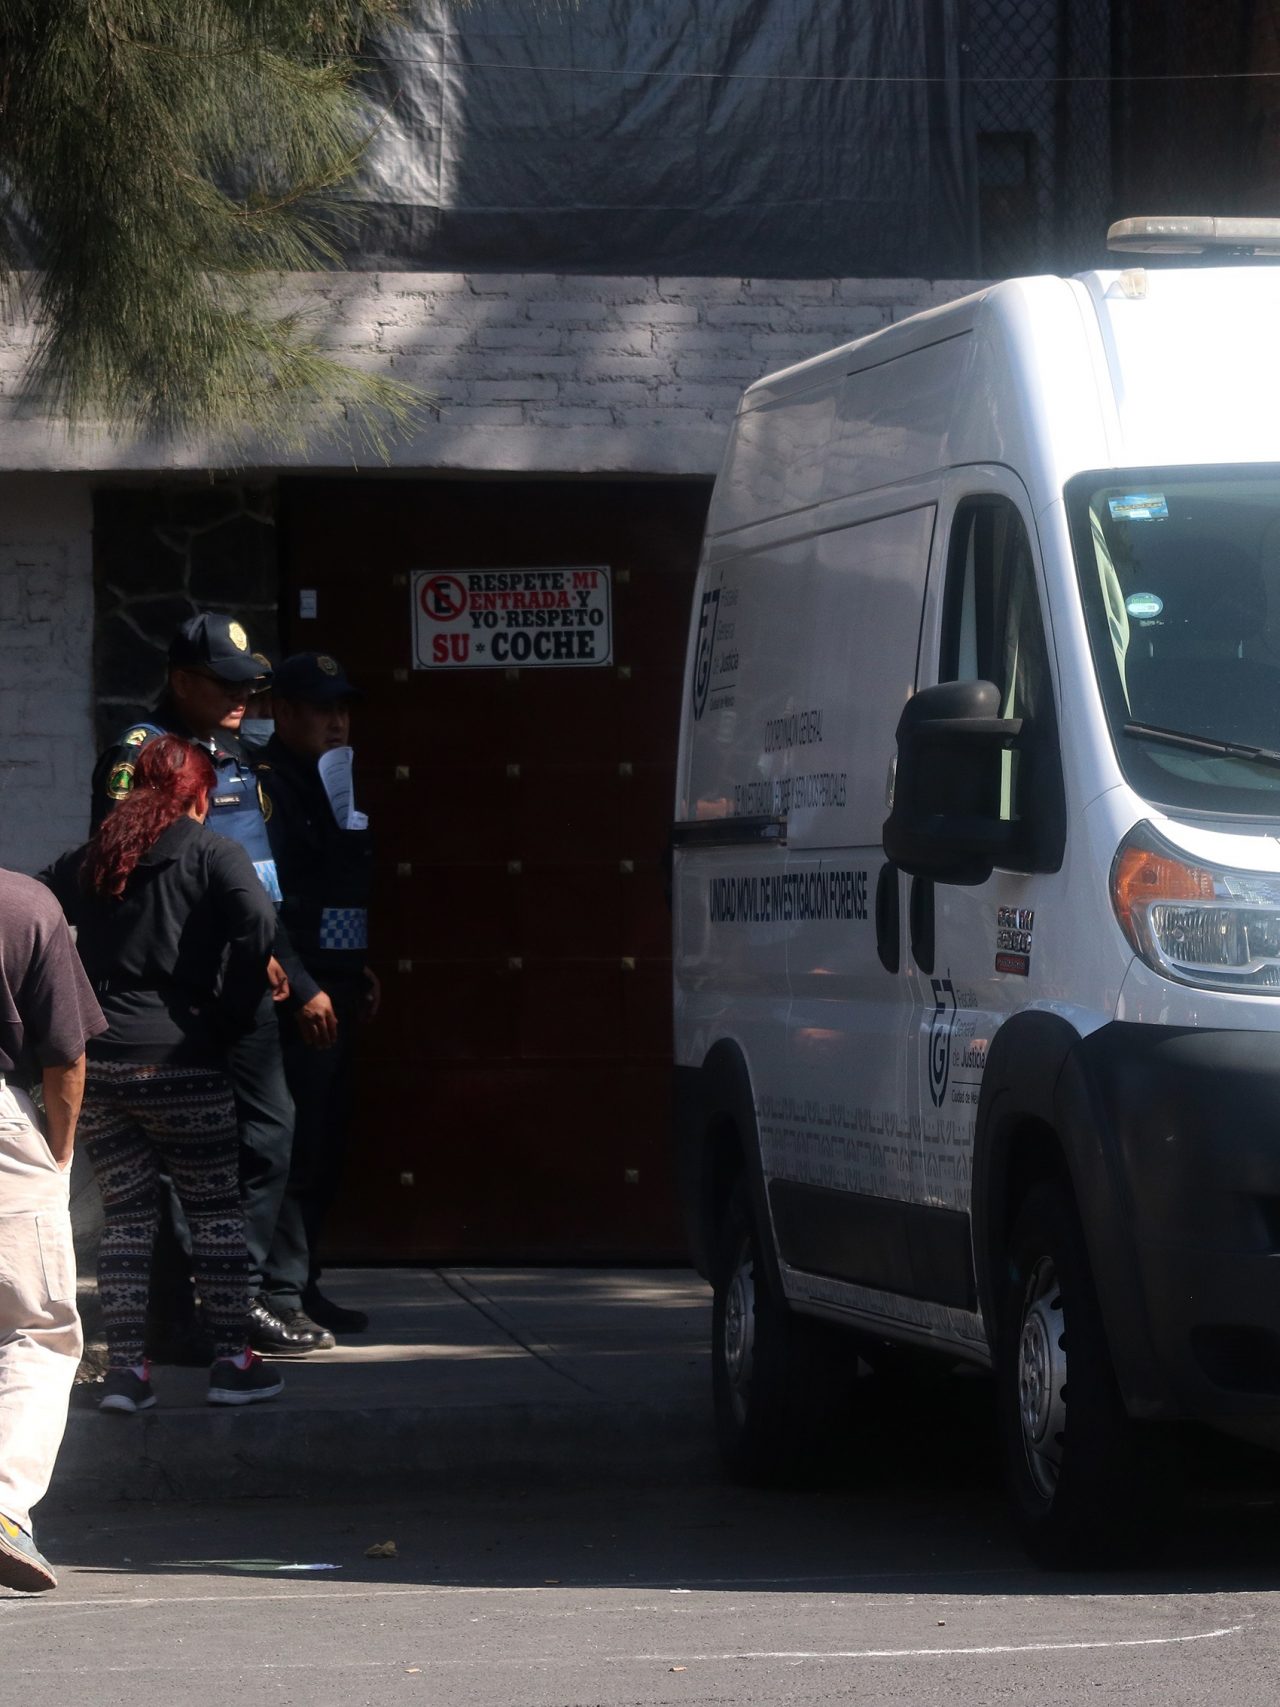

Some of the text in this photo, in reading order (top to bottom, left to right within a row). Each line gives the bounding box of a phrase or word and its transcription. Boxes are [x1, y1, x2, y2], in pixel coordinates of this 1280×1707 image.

[468, 571, 599, 592] RESPETE MI
[469, 590, 591, 610] ENTRADA Y
[469, 608, 604, 629] YO RESPETO
[432, 630, 596, 663] SU COCHE
[710, 878, 737, 922] UNIDAD
[760, 877, 770, 921] DE
[830, 872, 868, 920] FORENSE
[960, 1046, 986, 1069] Justicia
